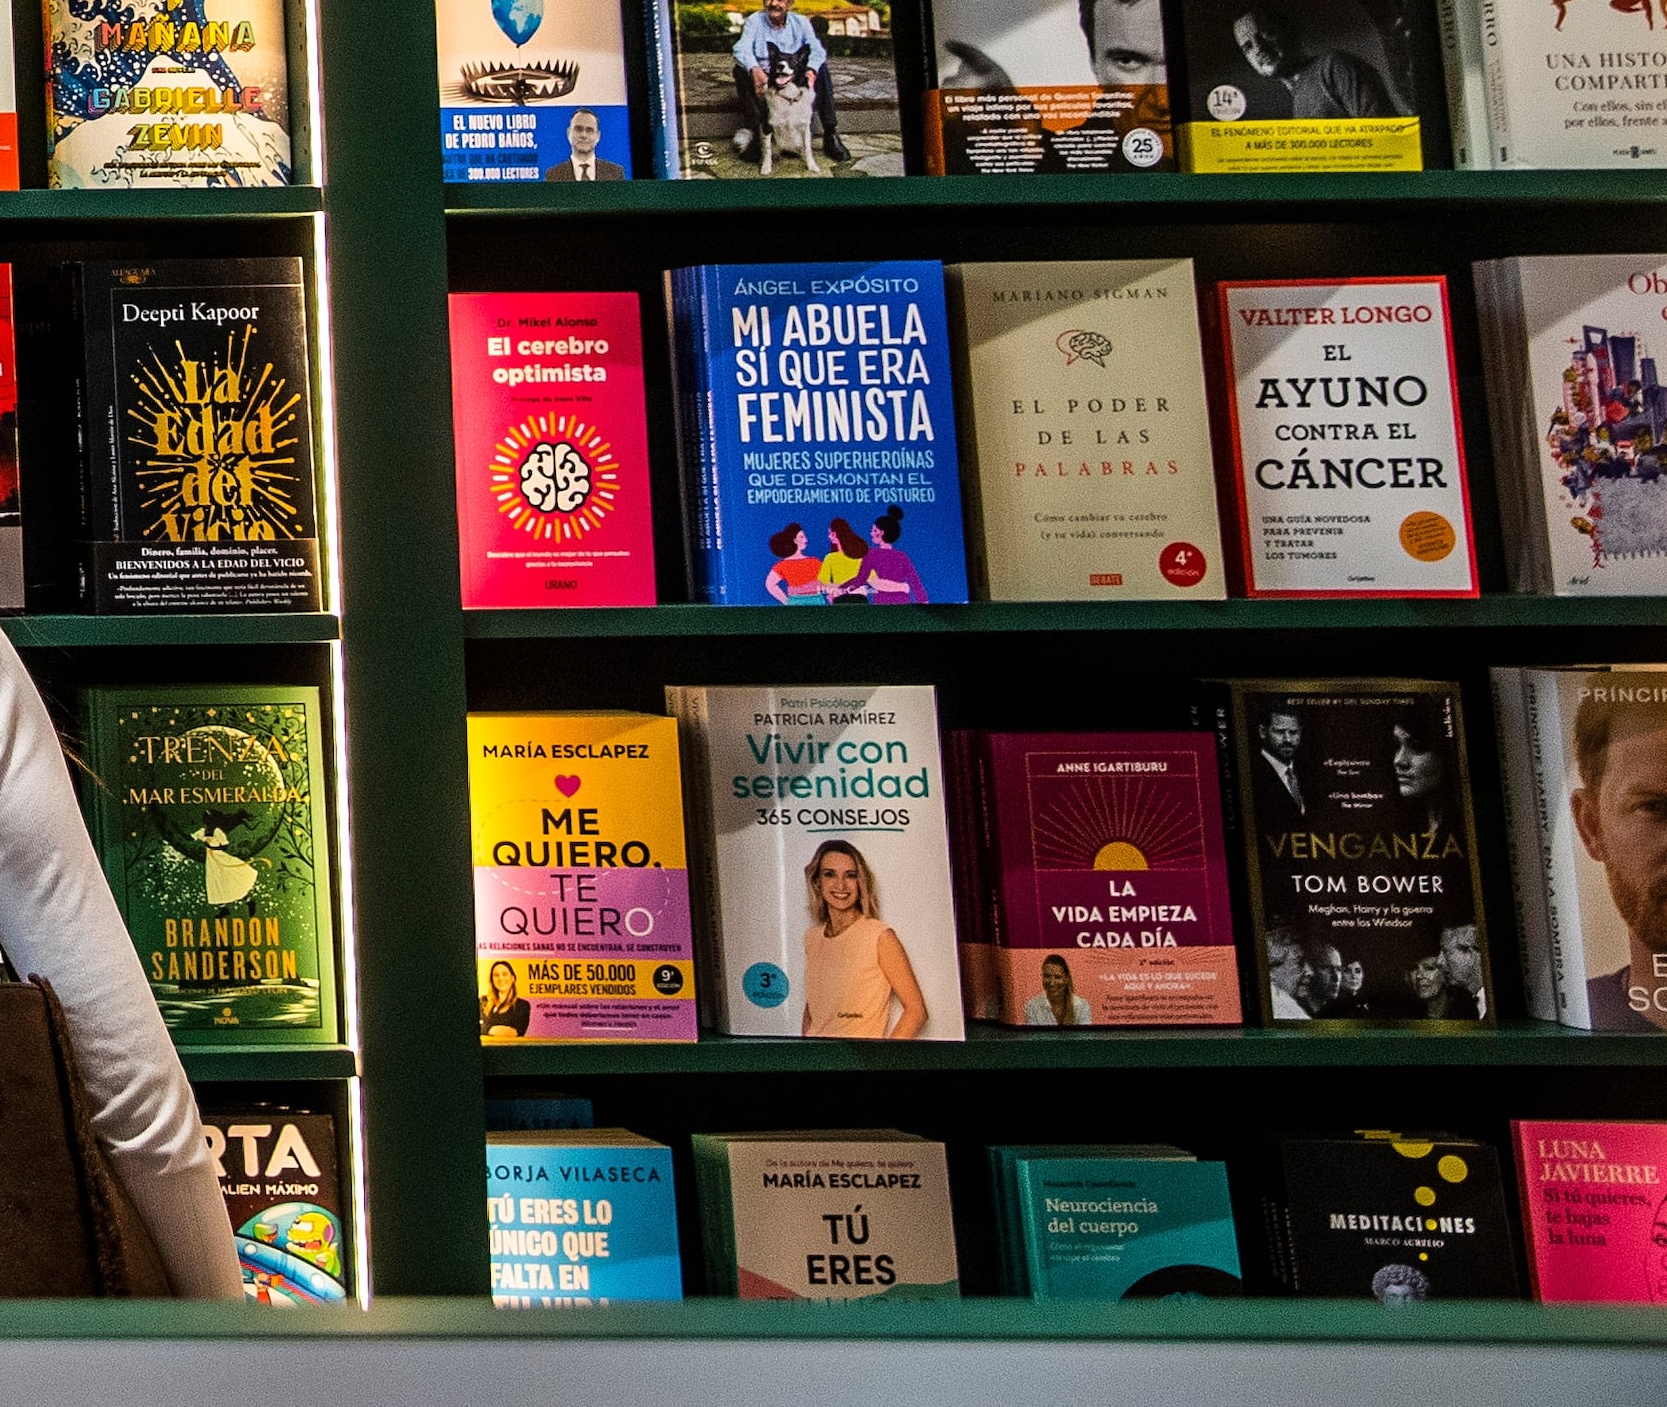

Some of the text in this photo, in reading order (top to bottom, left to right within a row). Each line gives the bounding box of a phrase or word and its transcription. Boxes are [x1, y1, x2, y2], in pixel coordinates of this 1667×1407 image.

[122, 303, 259, 327] Deepti Kapoor
[732, 304, 927, 348] MI ABUELA
[1238, 305, 1432, 325] VALTER LONGO
[488, 337, 609, 355] El cerebro
[1324, 345, 1351, 361] EL
[493, 364, 607, 387] optimista
[736, 346, 929, 391] SÍ QUE ERA
[1255, 375, 1428, 409] AYUNO
[737, 389, 934, 443] FEMINISTA
[1275, 423, 1416, 441] CONTRA EL
[1256, 448, 1446, 489] CÁNCER
[482, 740, 649, 760] MARÍA ESCLAPEZ
[746, 734, 908, 764] Vivir con
[732, 766, 929, 799] serenidad
[1291, 874, 1443, 893] TOM BOWER
[166, 918, 279, 948] BRANDON
[151, 950, 296, 980] SANDERSON
[1537, 1140, 1604, 1159] LUNA
[1540, 1164, 1659, 1184] JAVIERRE
